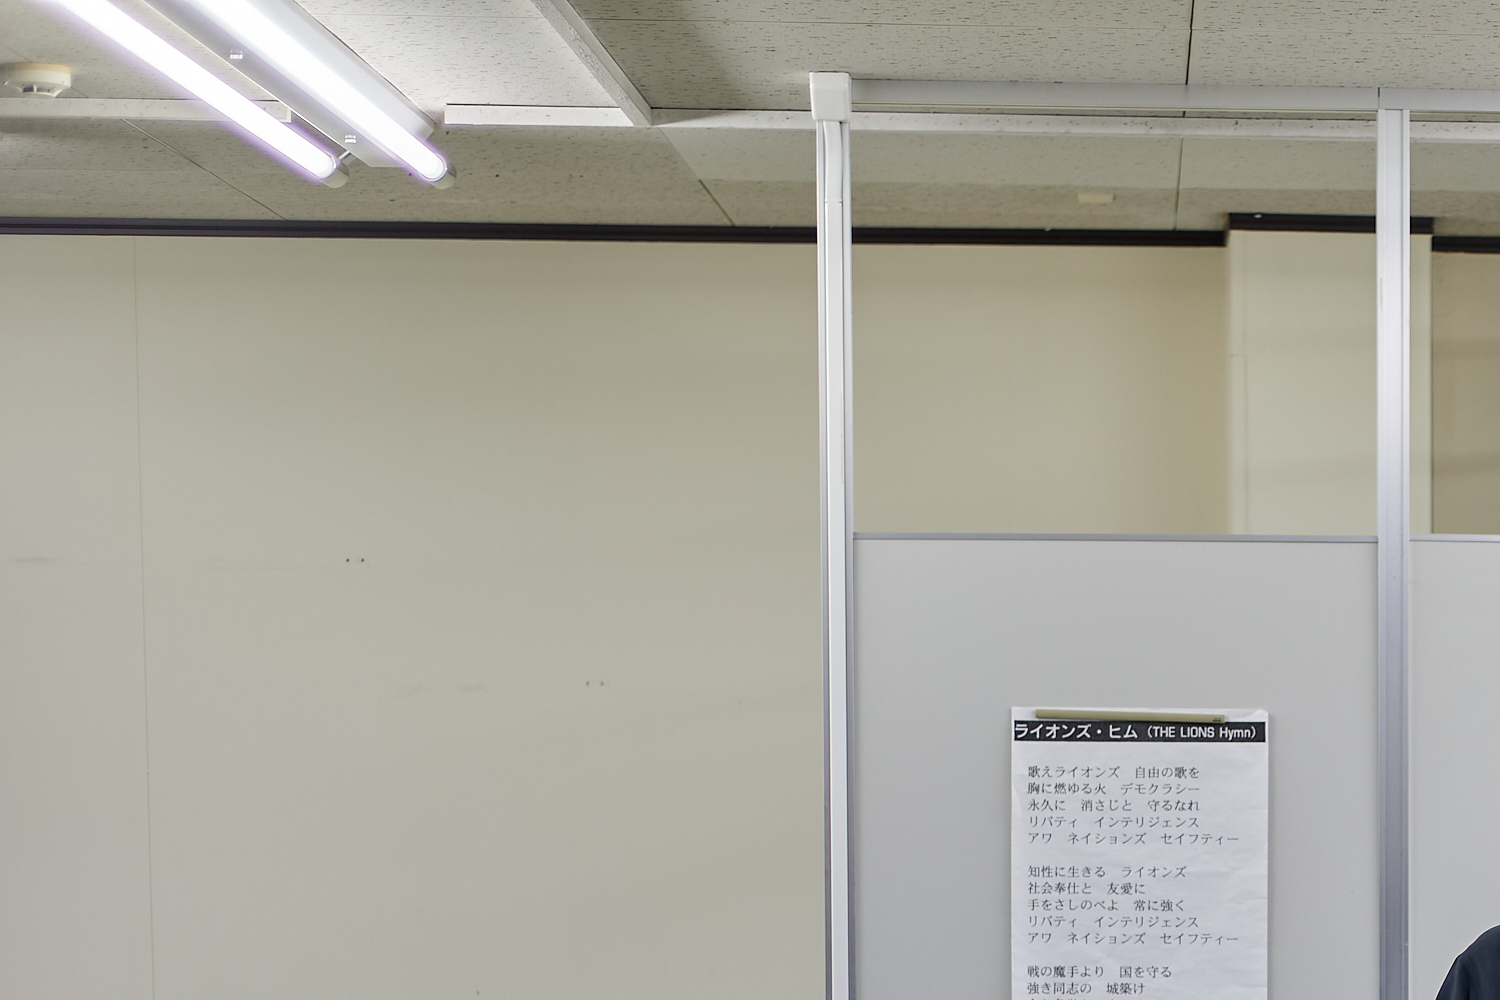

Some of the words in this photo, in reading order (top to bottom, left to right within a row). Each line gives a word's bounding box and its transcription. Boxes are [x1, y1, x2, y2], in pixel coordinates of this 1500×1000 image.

[1015, 723, 1138, 739] ライオンズ・ヒム
[1180, 726, 1215, 738] LIONS
[1028, 765, 1121, 779] 歌えライオンズ
[1135, 765, 1200, 779] 自由の歌を
[1027, 781, 1107, 795] 胸に燃ゆる火
[1120, 782, 1200, 796] デモクラシー
[1027, 798, 1066, 812] 永久に
[1080, 799, 1132, 812] 消さじと
[1147, 799, 1199, 813] 守るなれ
[1029, 815, 1077, 829] リバティ
[1094, 816, 1199, 829] インテリジェンス
[1028, 832, 1053, 844] アワ
[1067, 832, 1147, 845] ネイションズ
[1160, 832, 1239, 846] セイフティー
[1028, 865, 1106, 878] 知性に生きる
[1121, 865, 1187, 879] ライオンズ
[1027, 881, 1092, 895] 社会奉仕と
[1107, 881, 1146, 896] 友愛に
[1027, 898, 1119, 912] 手をさしのべよ
[1133, 898, 1184, 912] 常に強く
[1029, 915, 1077, 929] リバティ
[1094, 916, 1199, 928] インテリジェンス
[1028, 932, 1052, 944] アワ
[1068, 931, 1147, 945] ネイションズ
[1159, 932, 1239, 946] セイフティー
[1027, 964, 1104, 979] 戦の魔手より
[1119, 965, 1172, 979] 国を守る
[1027, 981, 1092, 995] 強き同志の
[1106, 982, 1146, 996] 城築け
